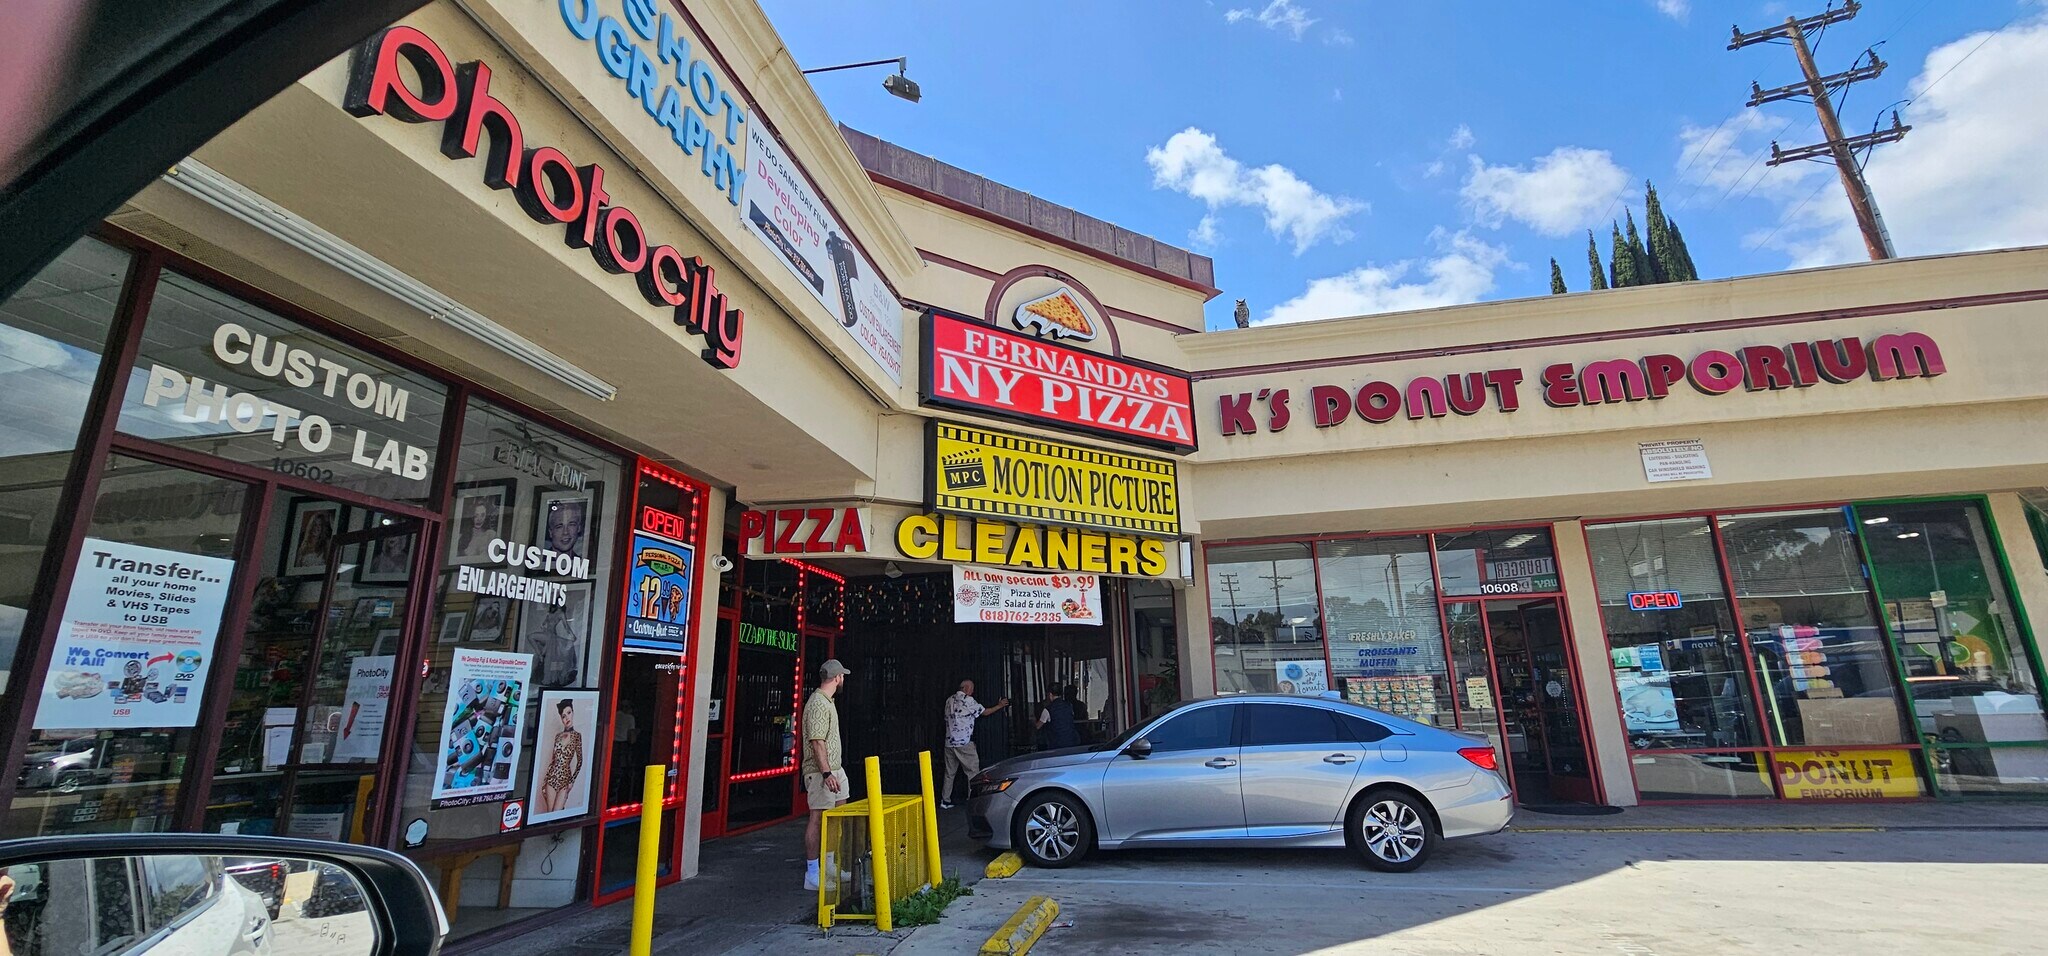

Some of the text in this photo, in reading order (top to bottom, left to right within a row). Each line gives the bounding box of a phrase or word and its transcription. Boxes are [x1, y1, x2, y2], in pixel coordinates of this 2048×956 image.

[751, 127, 828, 233] WE DO SAME DAY FILM
[757, 159, 820, 248] Developing
[774, 206, 803, 248] Color
[964, 329, 1168, 398] FERNANDA'S
[213, 323, 409, 422] CUSTOM
[1219, 332, 1947, 436] K'S DONUT EMPORIUM
[940, 354, 1190, 441] NY PIZZA
[143, 364, 428, 480] PHOTO LAB
[1642, 446, 1689, 455] ABSOLUTELY
[272, 457, 334, 484] 10602
[552, 461, 589, 492] PRINT
[950, 470, 981, 484] MPC
[993, 455, 1174, 516] MOTION PICTURE
[643, 510, 683, 538] OPEN
[739, 508, 866, 554] PIZZA
[896, 514, 1166, 576] CLEANERS
[93, 551, 221, 584] Transfer...
[488, 538, 589, 580] CUSTOM
[112, 575, 197, 592] all your home
[457, 565, 567, 607] ENLARGEMENTS
[964, 570, 1094, 589] ALL DAY SPECIAL $9.99
[106, 586, 196, 604] Movies, Slides
[1011, 589, 1051, 599] Pizza Slice
[1481, 583, 1519, 594] 10608
[107, 599, 190, 615] & VHS Tapes
[1004, 599, 1027, 608] Salad
[1036, 600, 1055, 609] drink
[1632, 594, 1680, 608] OPEN
[124, 613, 168, 625] to USB
[980, 609, 1062, 622] (818)762-2335
[756, 627, 766, 645] BY
[766, 628, 778, 647] THE
[778, 630, 798, 652] SLICE
[1349, 630, 1416, 641] FRESHLY BAKED
[69, 647, 150, 660] We Convert
[1359, 647, 1418, 657] CROISSANTS
[1618, 653, 1628, 663] A
[66, 656, 105, 666] it All!
[1360, 658, 1398, 667] MUFFIN
[356, 668, 389, 679] PhotoCity
[112, 708, 131, 716] USB
[1777, 759, 1893, 785] DONUT
[1800, 788, 1883, 799] EMPORIUM
[440, 799, 471, 808] PhotoCity:
[505, 807, 520, 817] BAY
